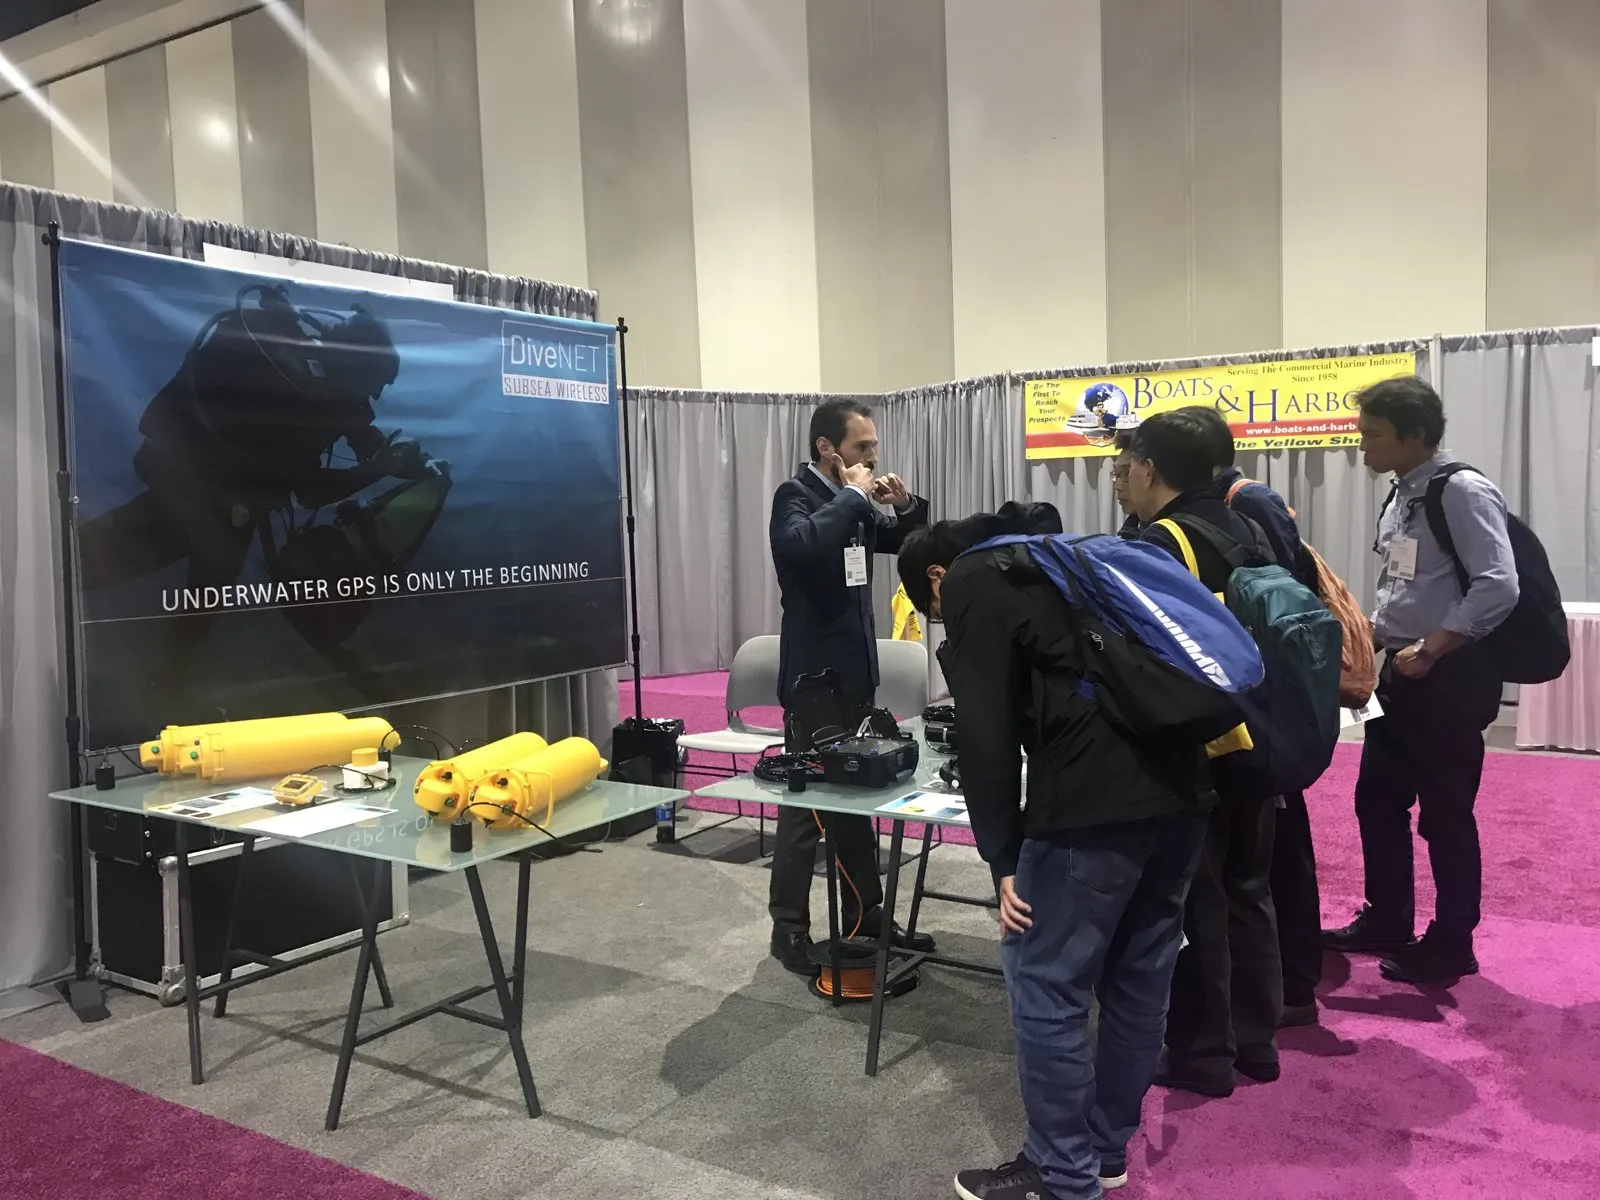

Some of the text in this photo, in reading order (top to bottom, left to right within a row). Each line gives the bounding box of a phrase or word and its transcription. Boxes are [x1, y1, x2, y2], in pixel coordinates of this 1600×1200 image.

[511, 335, 600, 373] DiveNET
[1227, 357, 1409, 376] Serving The Commercial Marine Industry
[1291, 373, 1338, 383] Since 1958
[503, 376, 608, 402] SUBSEA WIRELESS
[1133, 377, 1361, 424] BOATS & HARBO
[1028, 416, 1066, 424] Prospects
[1245, 422, 1357, 435] www.boats-and-harb
[1263, 438, 1324, 448] Yellow
[1329, 436, 1363, 445] She
[162, 561, 590, 612] UNDERWATER GPS IS ONLY THE BEGINNING
